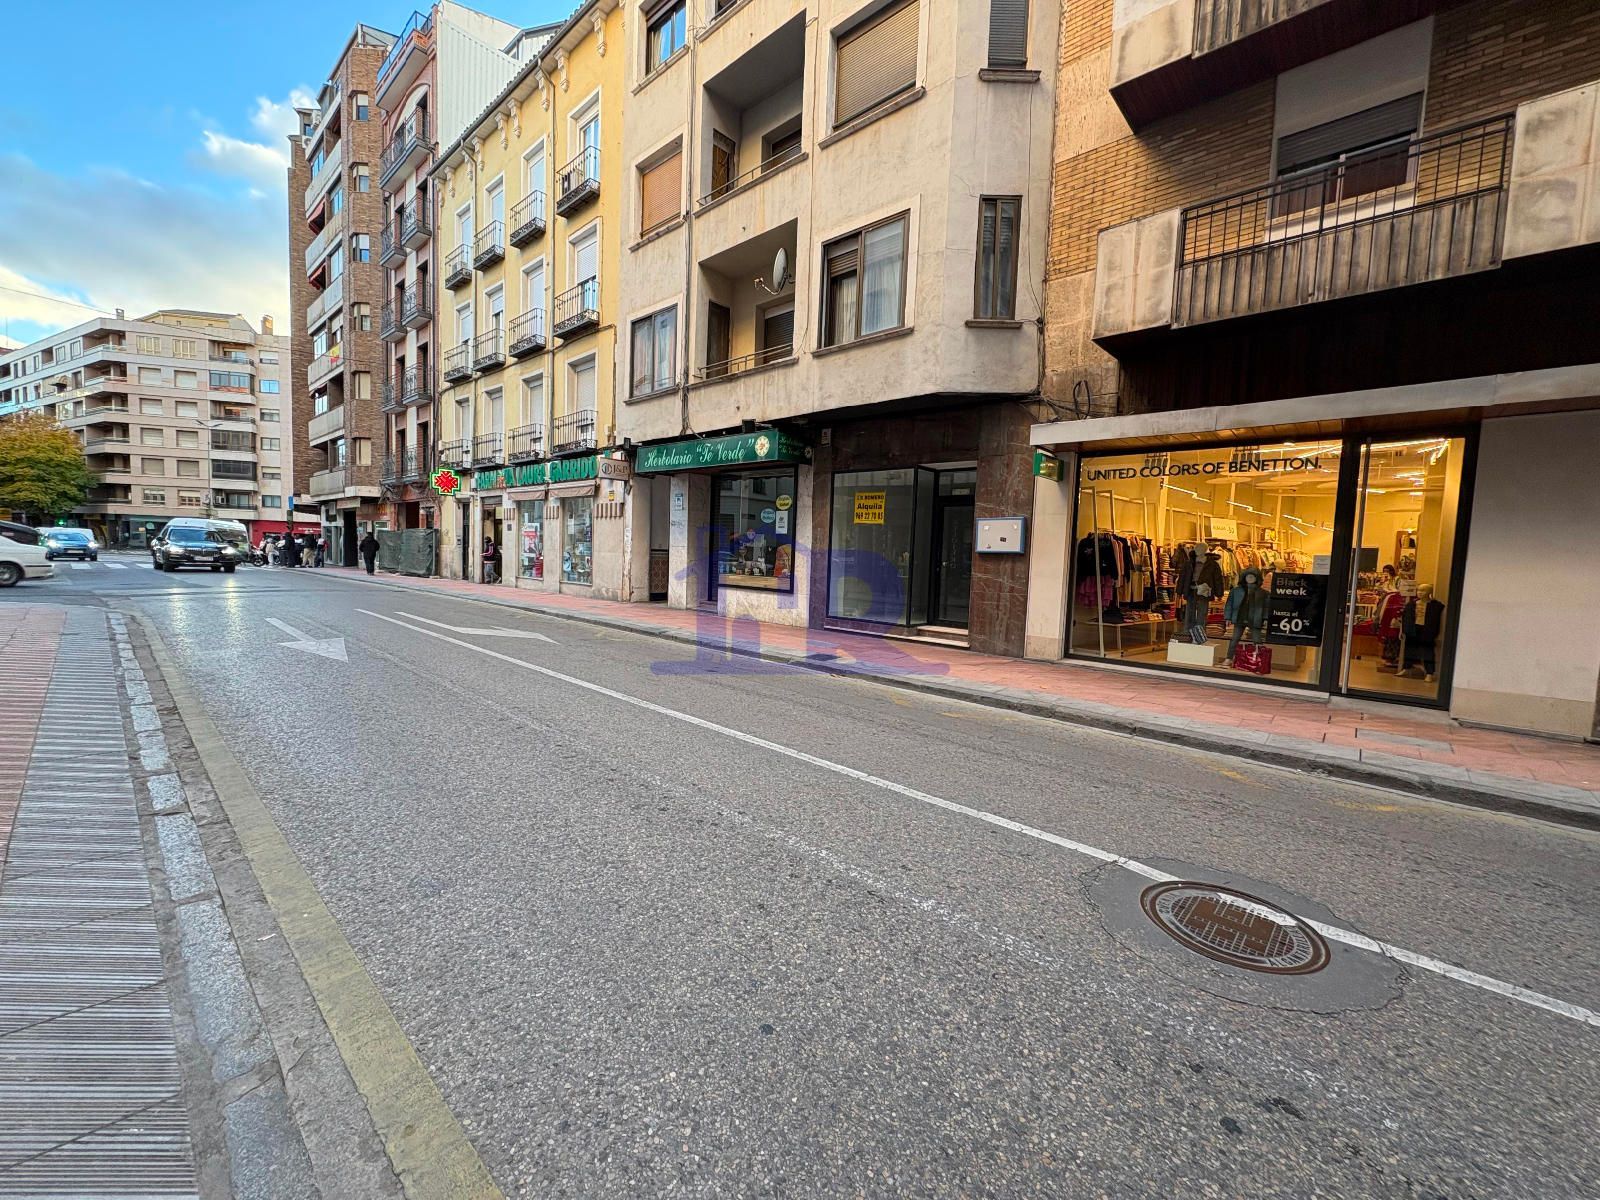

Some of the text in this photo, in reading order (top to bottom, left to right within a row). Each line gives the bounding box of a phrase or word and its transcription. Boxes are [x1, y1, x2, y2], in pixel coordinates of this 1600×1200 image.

[644, 449, 693, 468] Herbolario
[515, 463, 546, 487] LAURA
[549, 455, 599, 483] GARRIDO
[1087, 467, 1137, 482] UNITED
[1139, 463, 1200, 478] COLORS
[1202, 461, 1224, 474] OF
[858, 503, 882, 511] Alquila
[1276, 578, 1307, 587] Black
[1276, 587, 1307, 596] week
[1273, 609, 1291, 617] hasta
